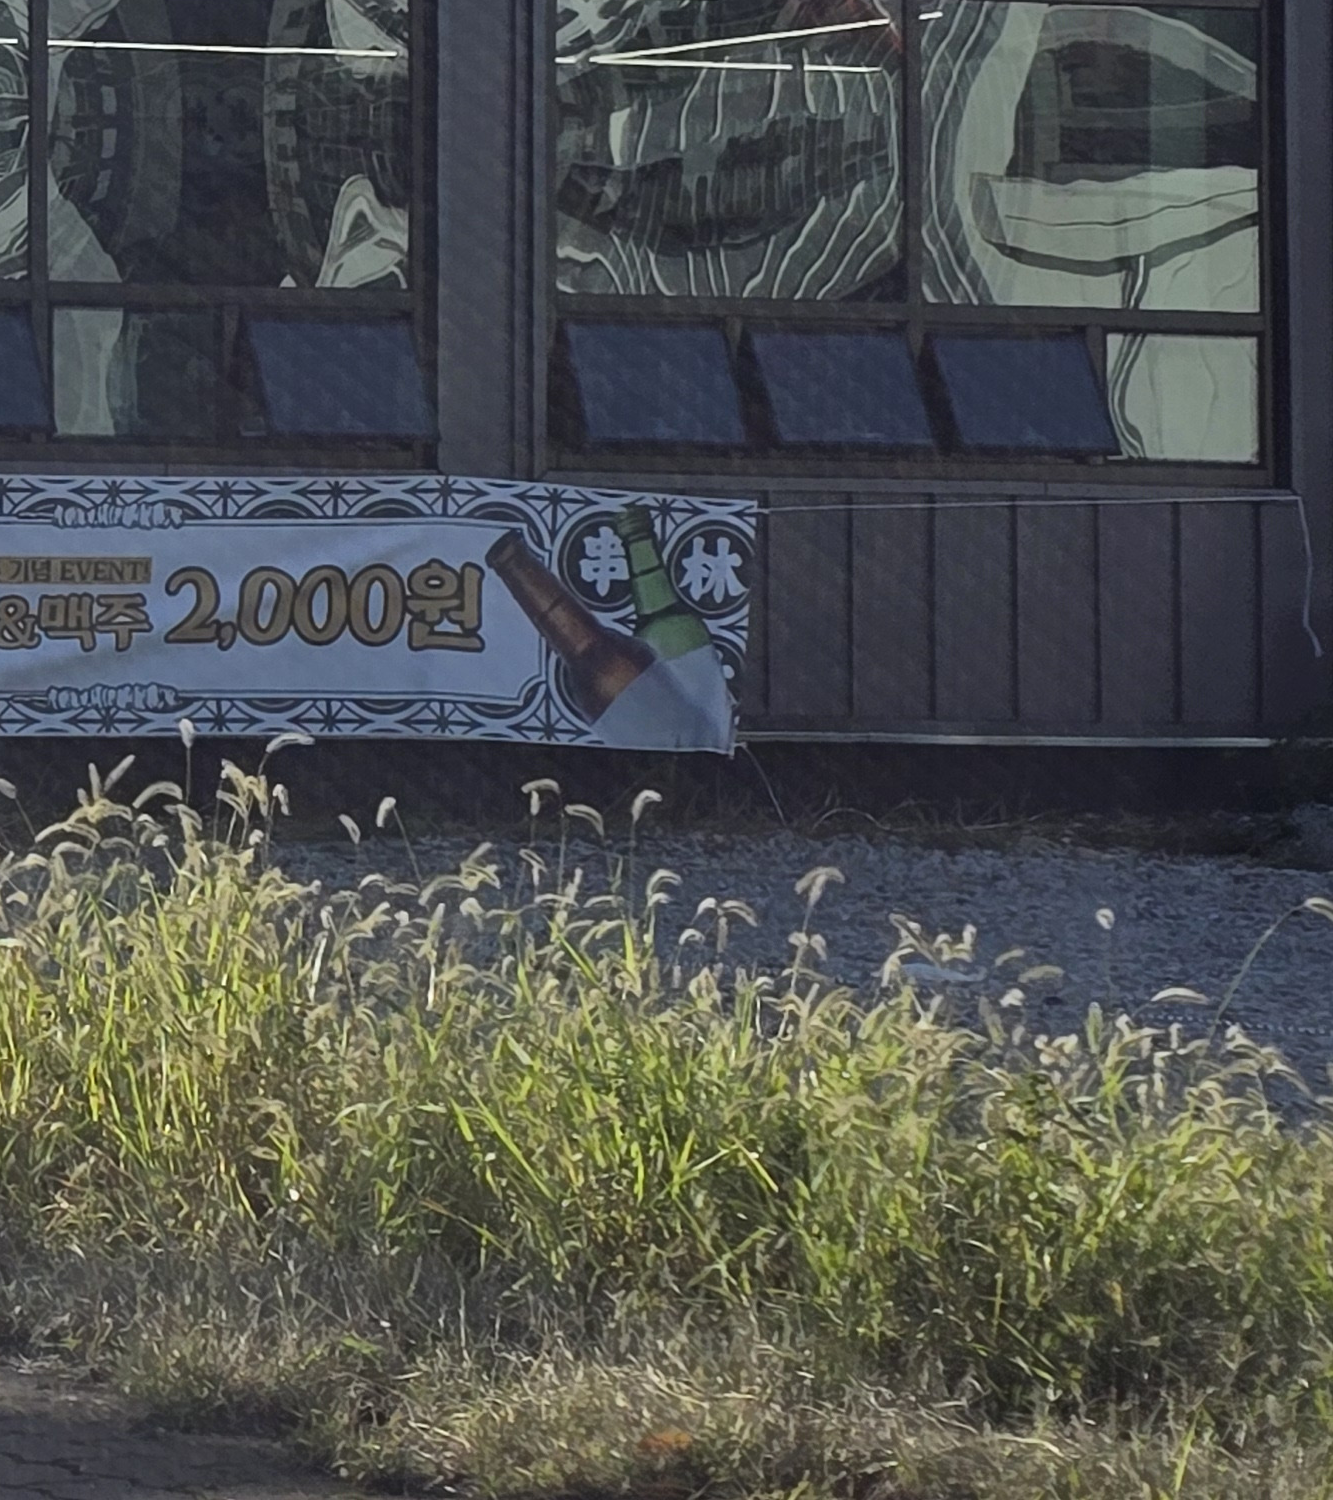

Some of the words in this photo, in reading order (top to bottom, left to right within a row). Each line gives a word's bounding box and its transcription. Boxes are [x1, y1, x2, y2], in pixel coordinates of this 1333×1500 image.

[10, 559, 52, 582] 기념
[60, 560, 150, 582] EVENT!
[164, 558, 487, 653] 2,000원
